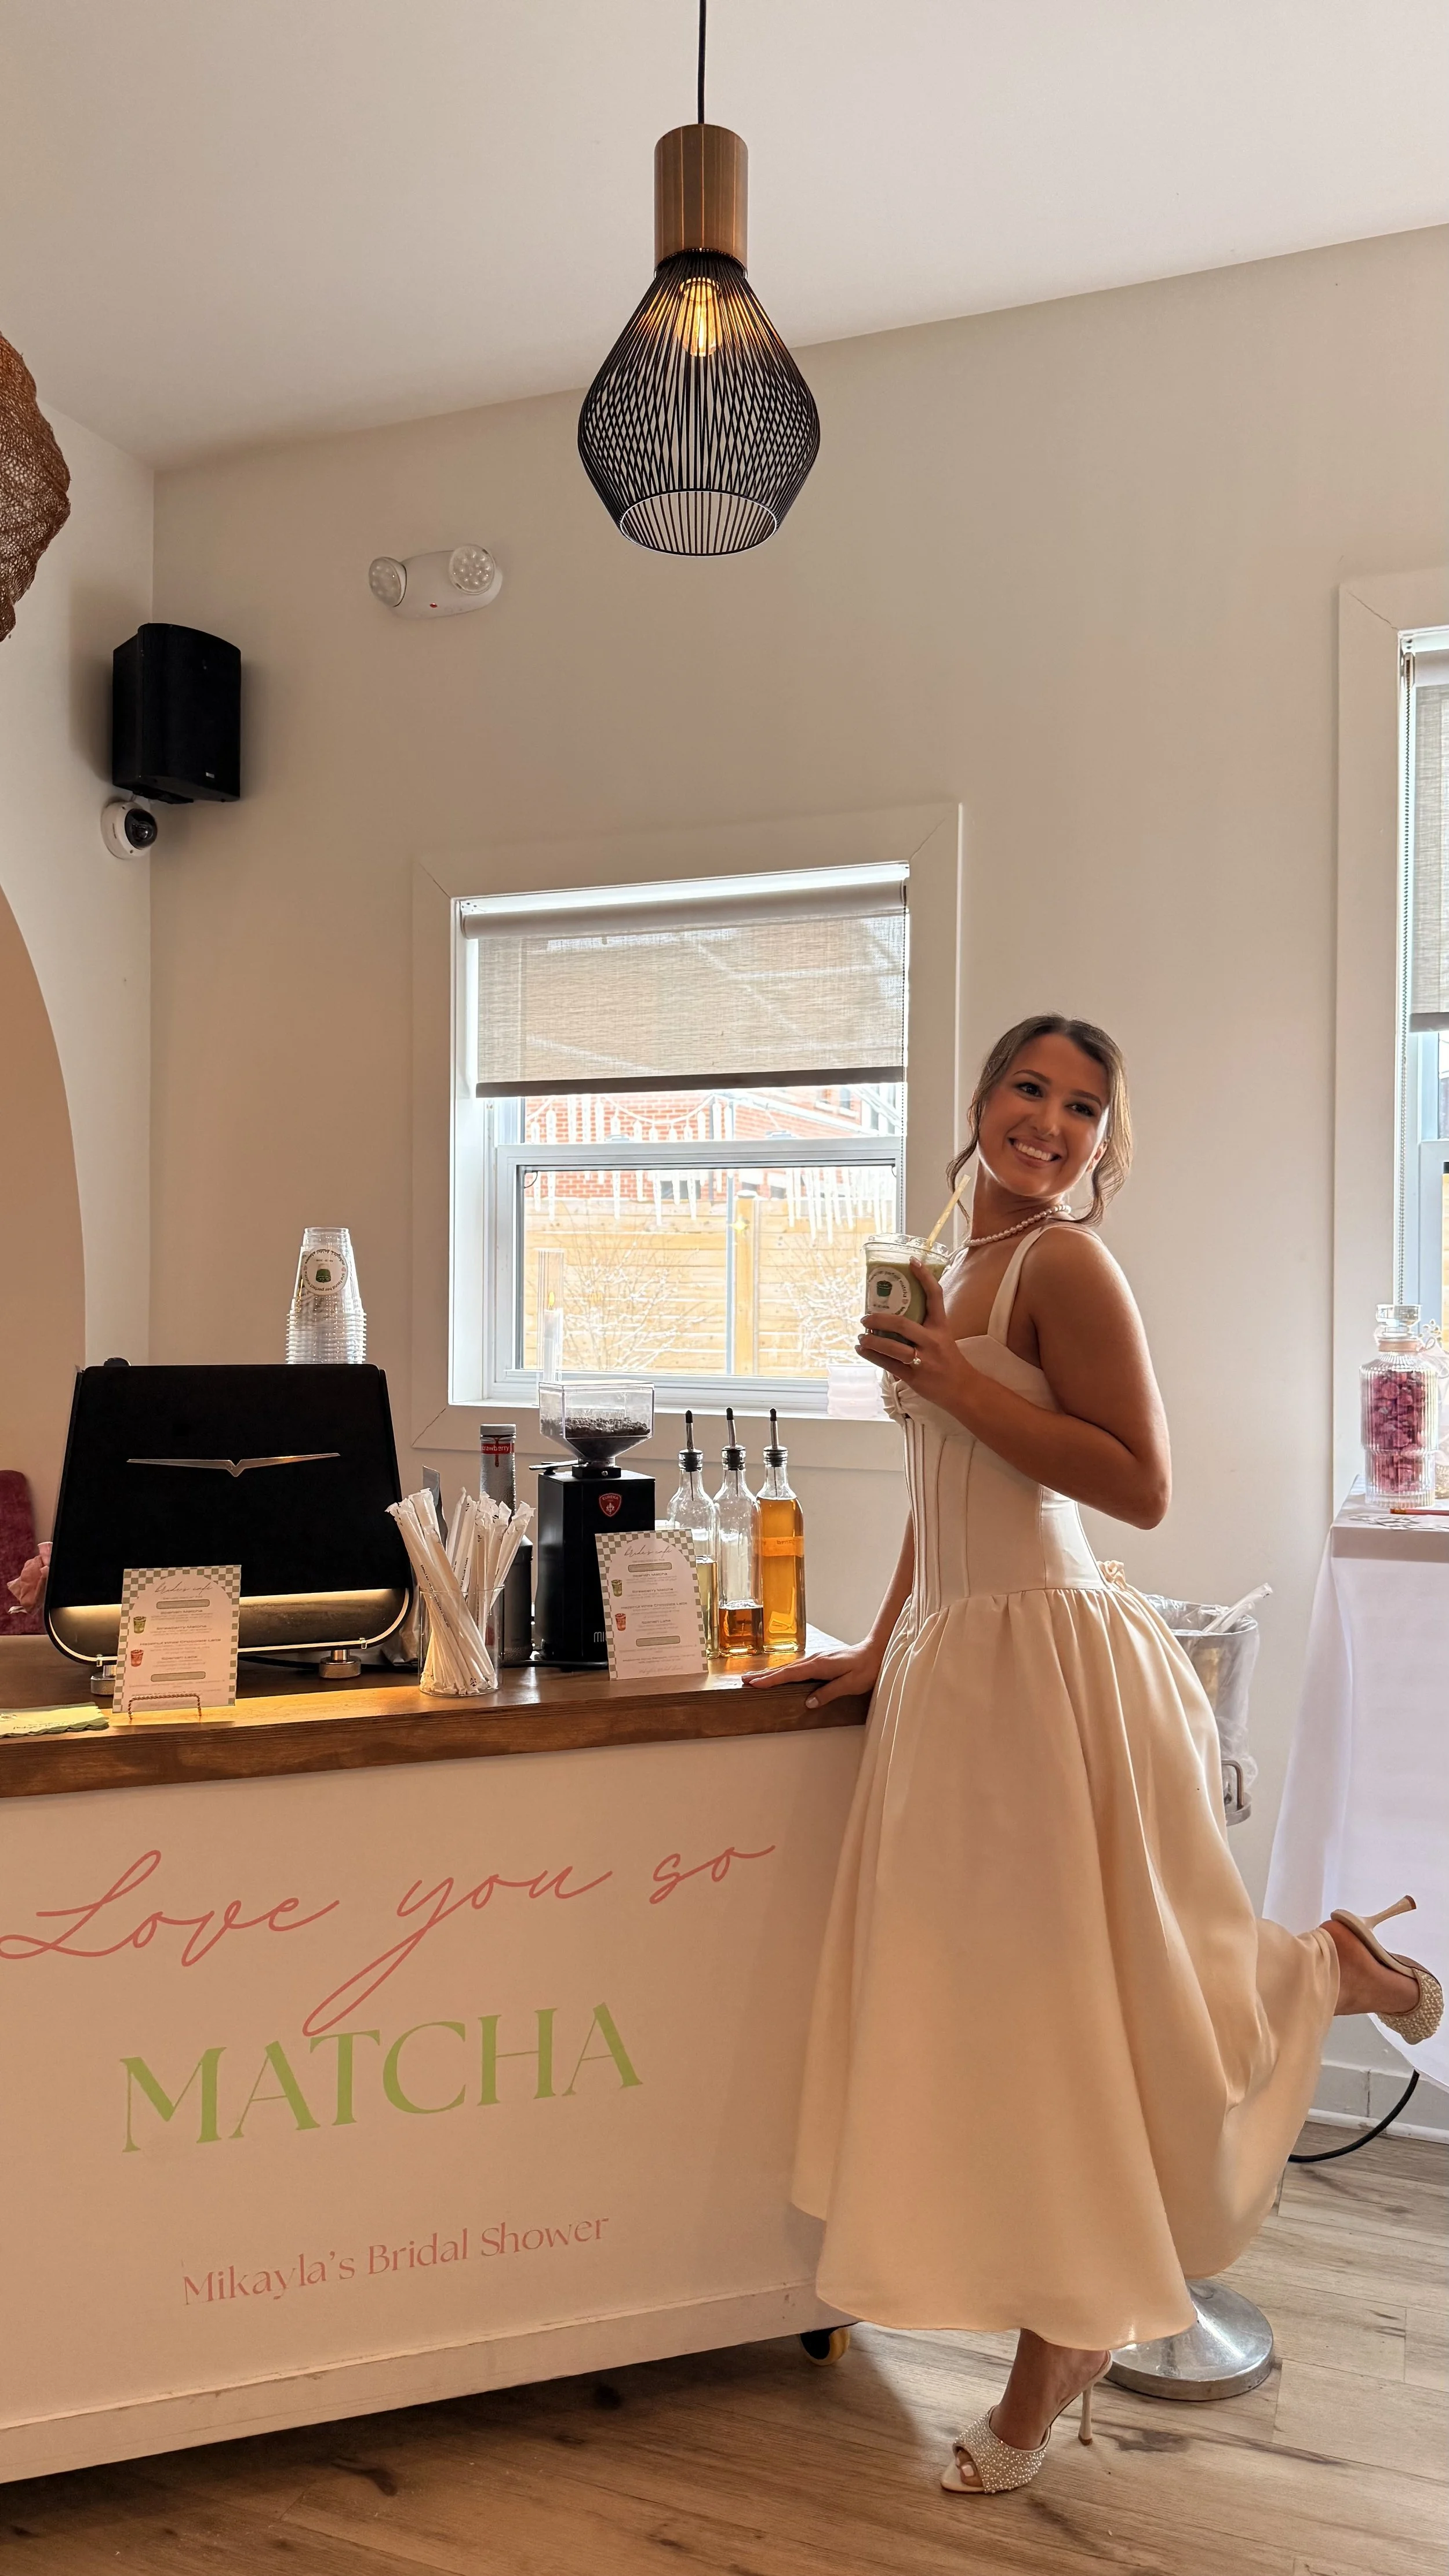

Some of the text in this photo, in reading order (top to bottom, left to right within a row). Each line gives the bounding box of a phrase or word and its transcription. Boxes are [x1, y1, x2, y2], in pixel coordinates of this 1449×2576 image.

[0, 1847, 775, 2038] Love you so
[119, 2002, 643, 2153] MATCHA
[183, 2217, 610, 2305] Mikayla's Bridal Shower
